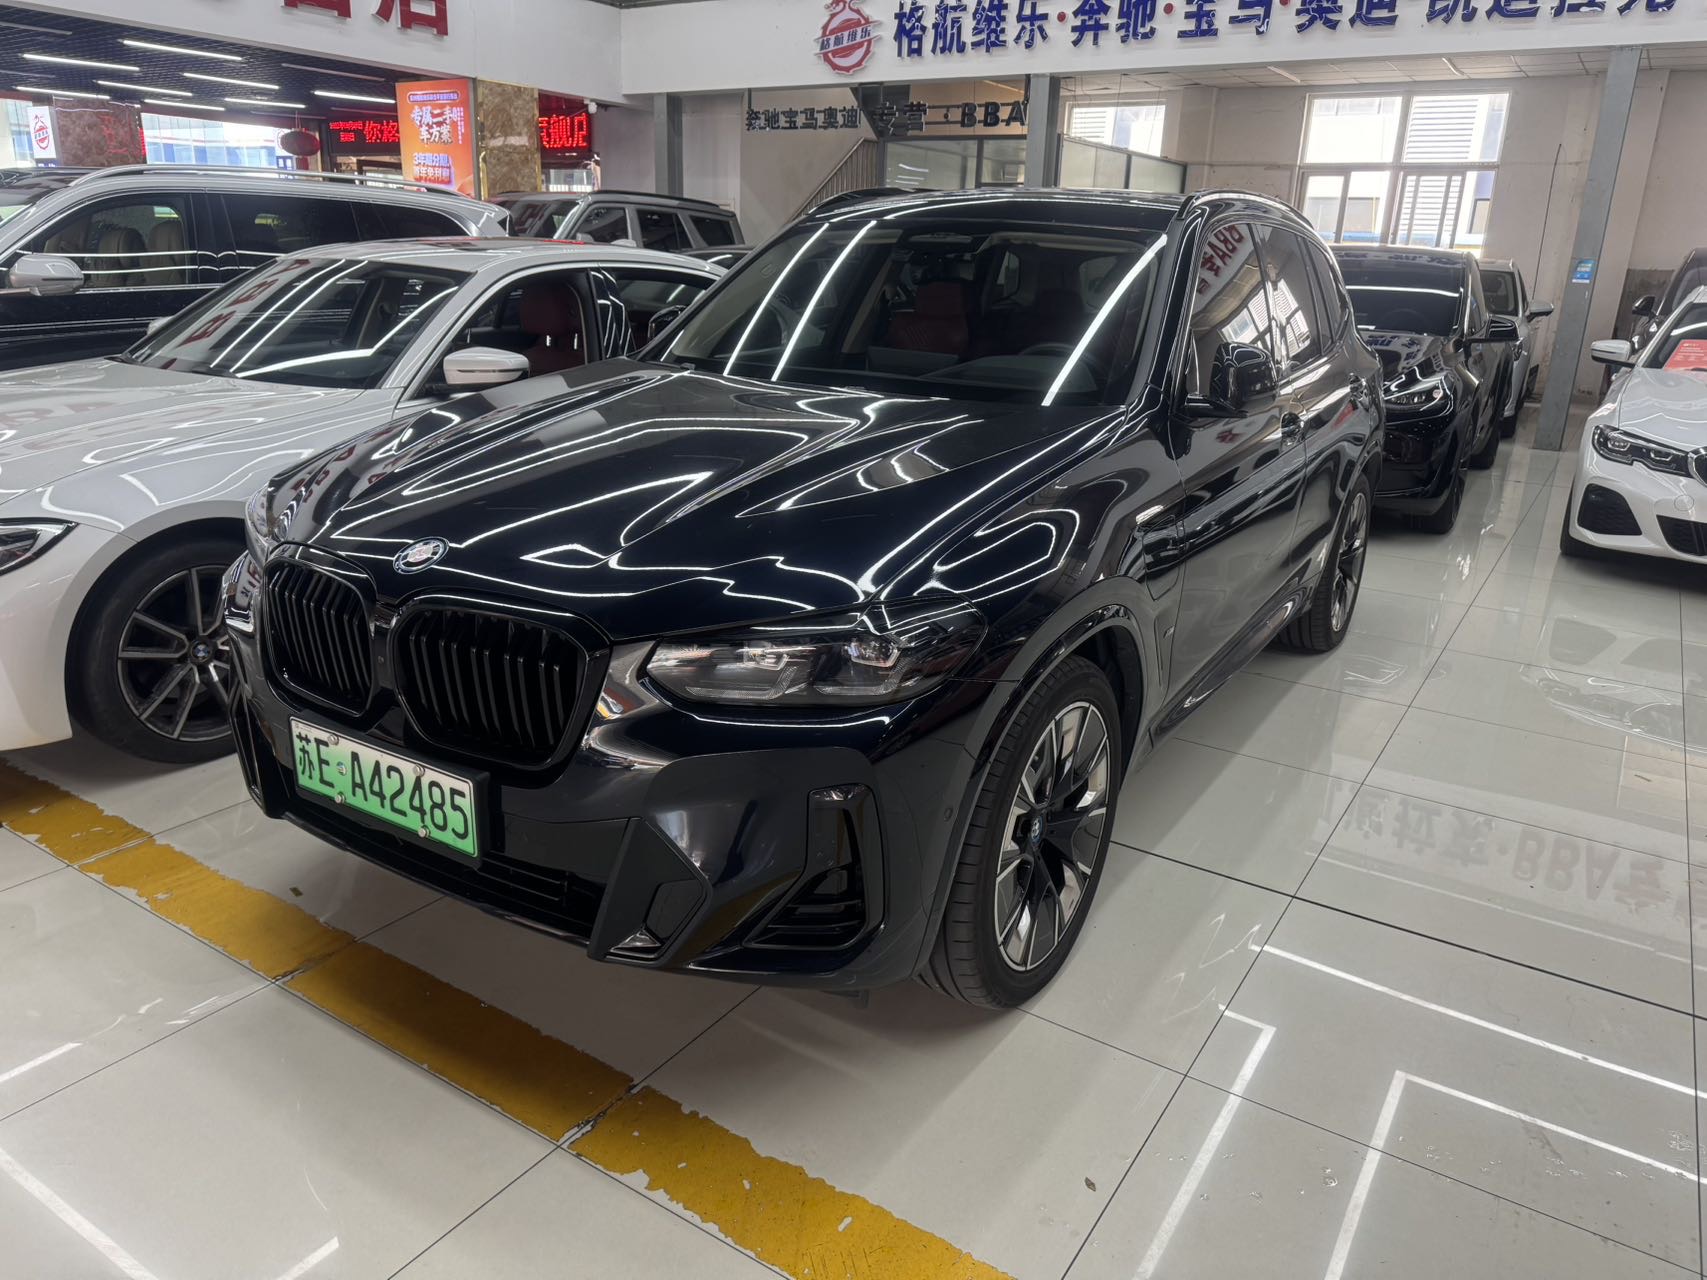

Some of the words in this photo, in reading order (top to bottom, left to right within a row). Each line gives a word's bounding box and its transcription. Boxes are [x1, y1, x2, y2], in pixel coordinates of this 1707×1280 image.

[819, 27, 872, 51] 格航维乐
[746, 105, 862, 131] 奔驰宝马奥迪
